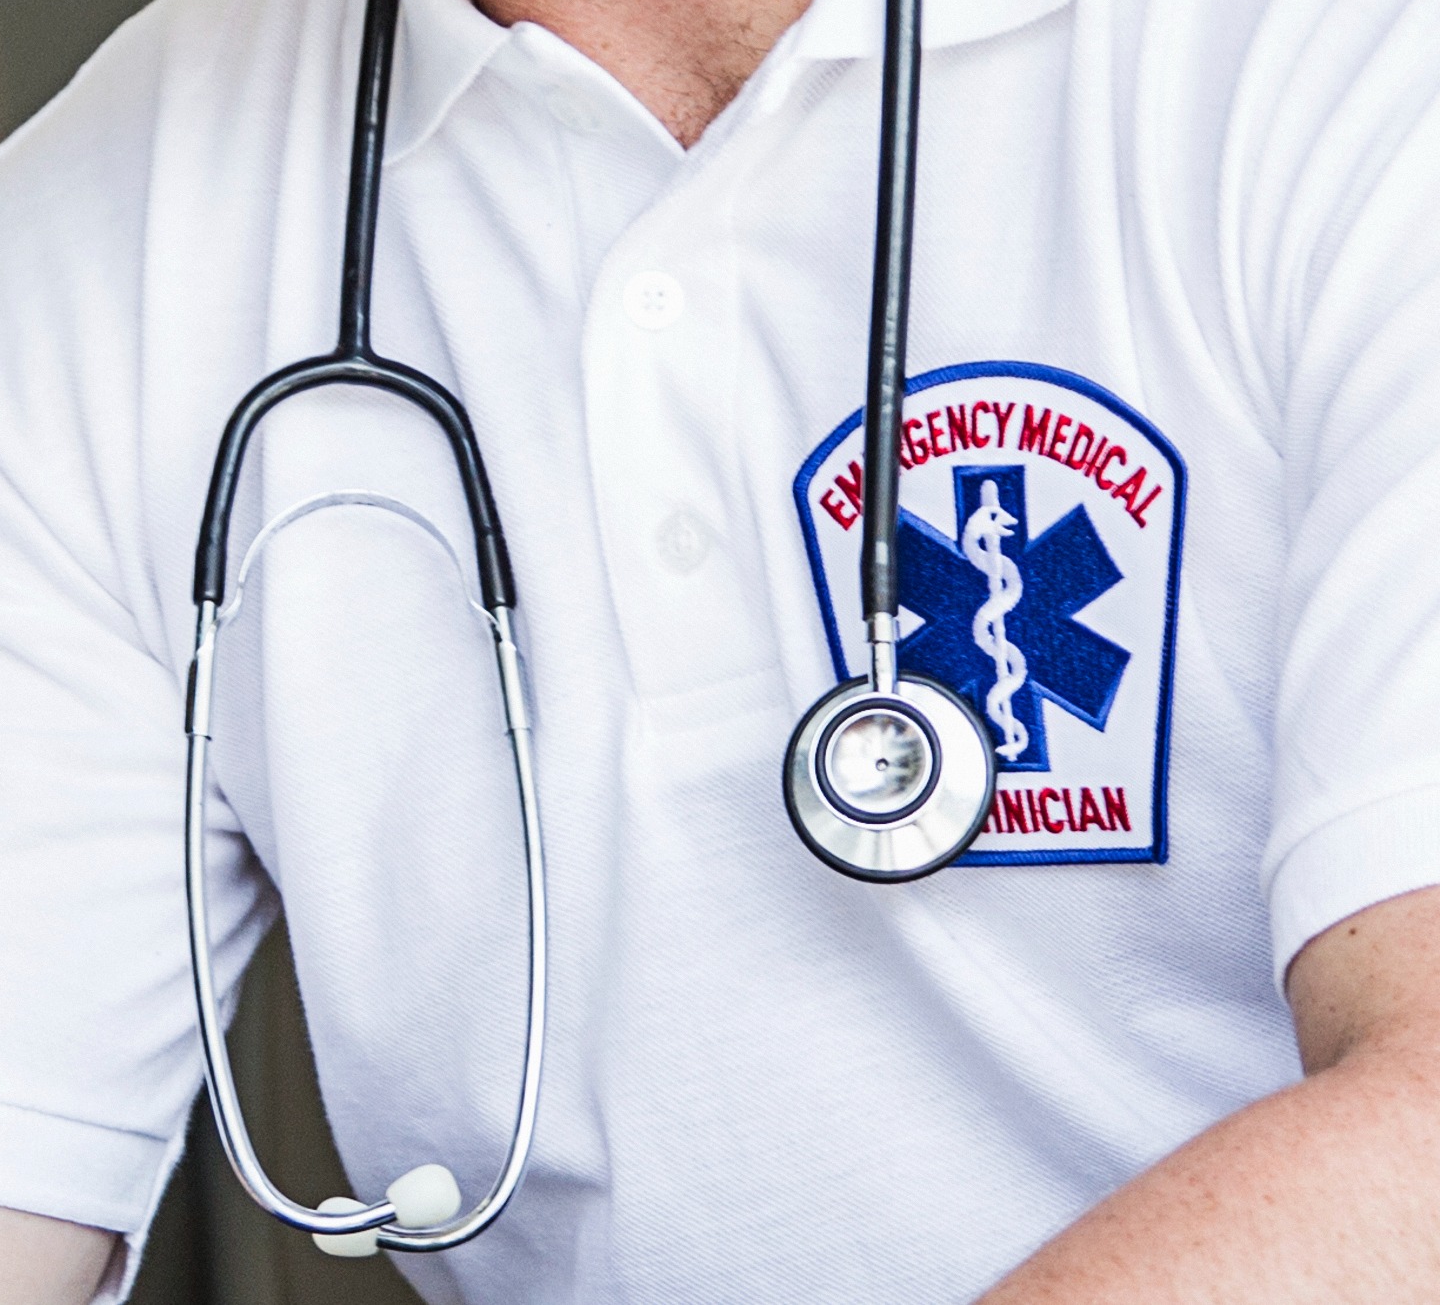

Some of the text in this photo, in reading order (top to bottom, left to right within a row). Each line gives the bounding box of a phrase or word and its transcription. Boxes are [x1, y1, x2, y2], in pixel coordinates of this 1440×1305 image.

[819, 400, 1163, 531] EMGENCY MEDICAL
[982, 786, 1132, 834] NICIAN
